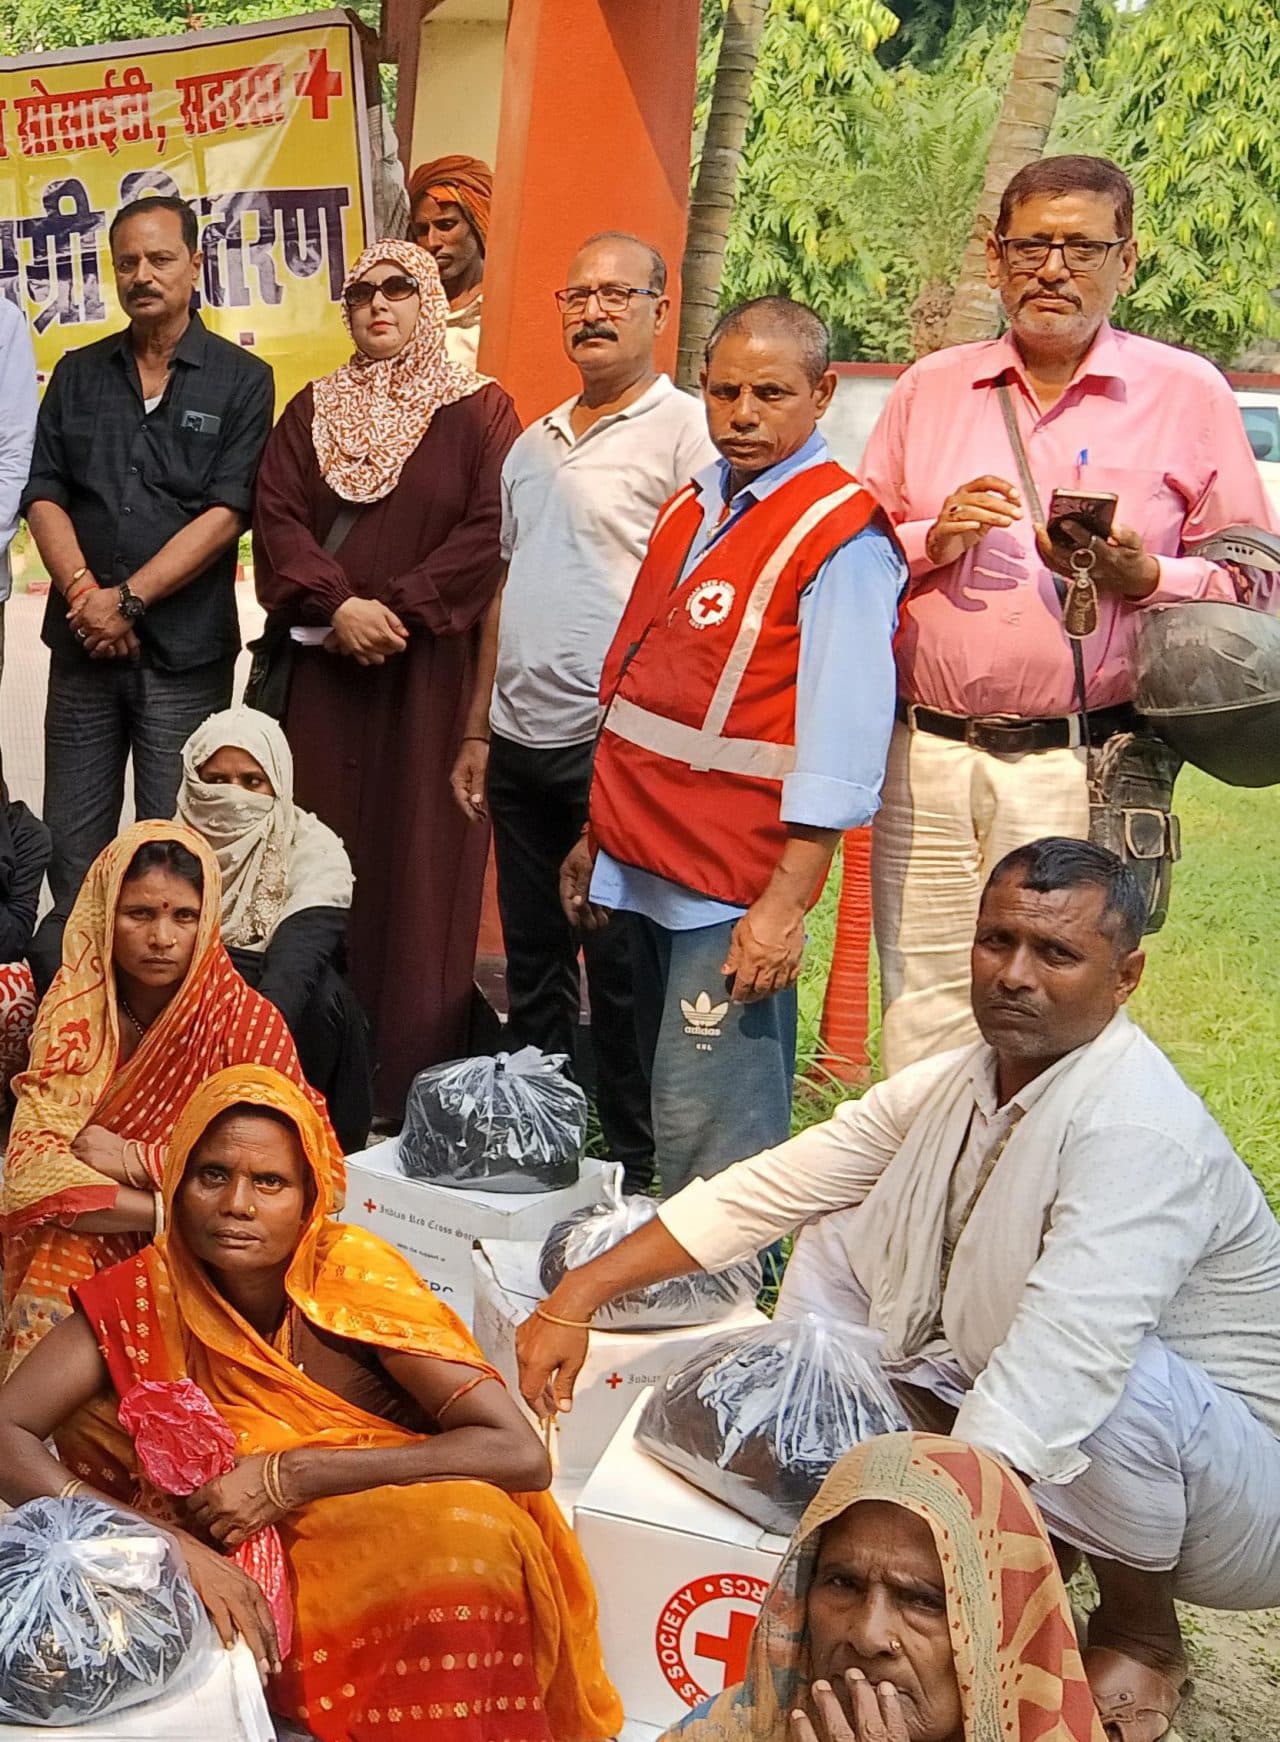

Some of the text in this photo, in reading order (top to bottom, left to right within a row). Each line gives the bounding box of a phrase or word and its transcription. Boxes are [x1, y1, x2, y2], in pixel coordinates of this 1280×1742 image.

[684, 1026, 721, 1037] adidas
[379, 1204, 406, 1220] Indian
[409, 1213, 425, 1226] Red
[428, 1220, 452, 1235] Cross
[720, 1578, 767, 1602] RCS
[659, 1588, 697, 1680] SOCIETY
